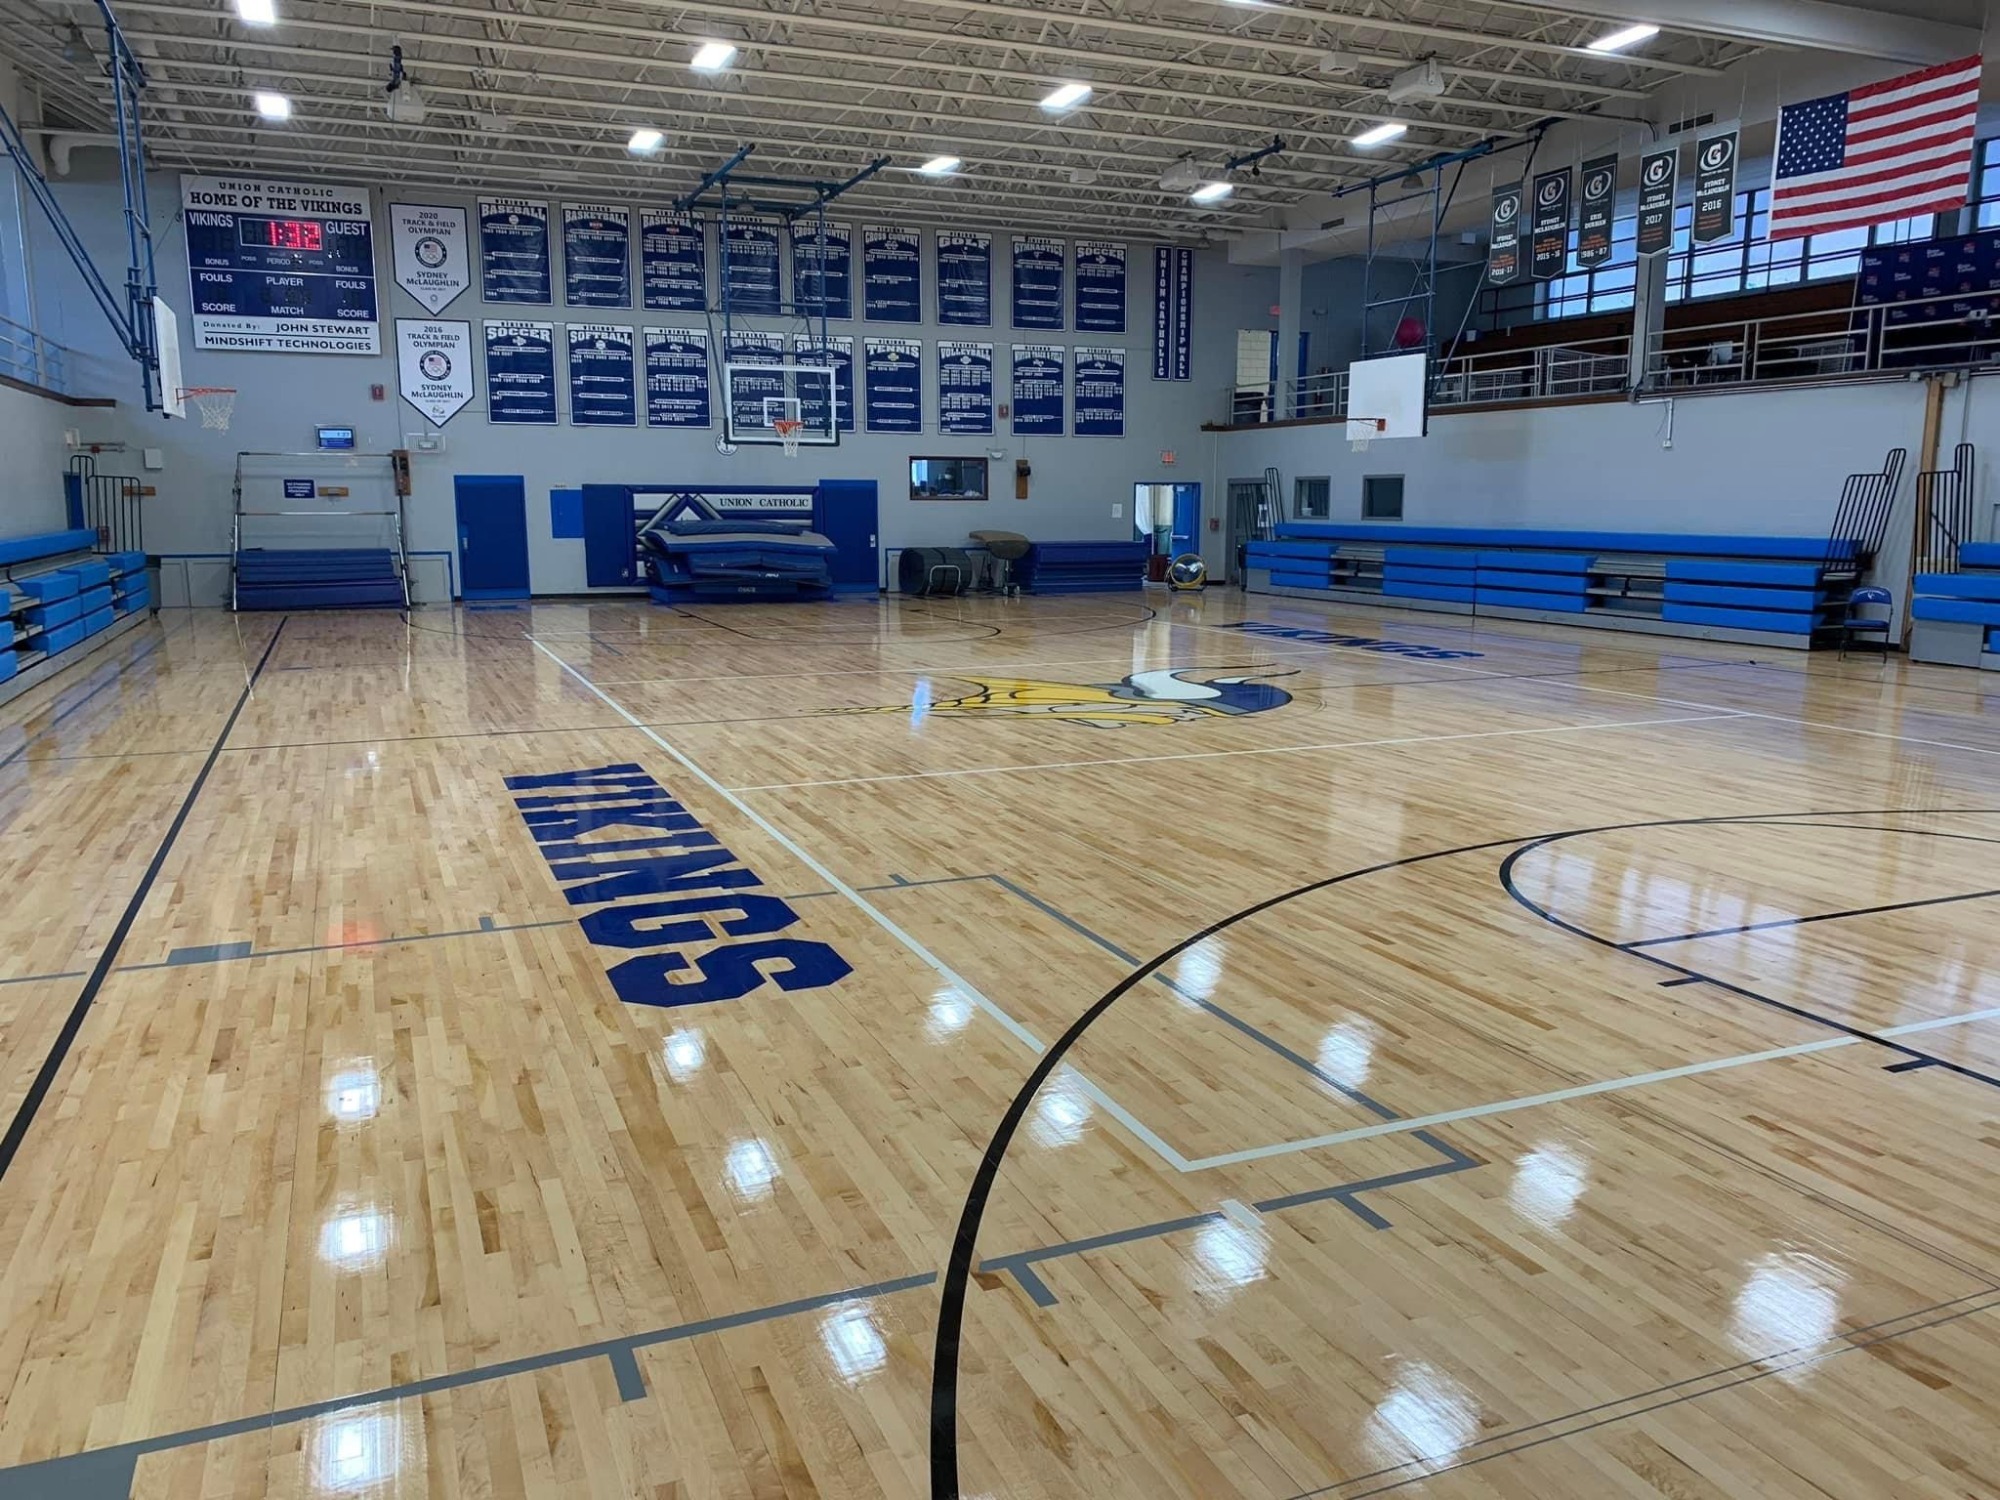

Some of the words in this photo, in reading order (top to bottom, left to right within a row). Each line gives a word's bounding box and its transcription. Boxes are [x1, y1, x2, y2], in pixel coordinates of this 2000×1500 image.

[219, 182, 261, 192] UNION
[268, 185, 333, 197] CATHOLIC
[190, 192, 237, 207] HOME
[241, 195, 262, 208] OF
[267, 197, 297, 211] THE
[300, 199, 363, 215] VIKINGS
[1702, 199, 1722, 211] 2016
[481, 204, 546, 221] BASEBALL
[565, 210, 627, 227] BASKETBALL
[189, 212, 234, 227] VIKINGS
[1645, 214, 1663, 225] 2017
[269, 221, 321, 249] 1:32
[325, 221, 367, 236] GUEST
[408, 226, 451, 235] OLYMPIAN
[865, 231, 887, 243] CROSS
[888, 233, 918, 247] COUNTRY
[939, 237, 990, 250] GOLF
[1014, 242, 1063, 257] GYMNASTICS
[1077, 247, 1125, 262] SOCCER
[205, 258, 229, 266] BONUS
[266, 257, 291, 266] PERIOD
[335, 265, 359, 274] BONUS
[416, 271, 448, 279] SYDNEY
[200, 273, 233, 283] FOULS
[266, 276, 304, 287] PLAYER
[406, 278, 459, 287] McLAUGHLIN
[335, 280, 367, 290] FOULS
[202, 302, 236, 313] SCORE
[271, 306, 304, 315] MATCH
[337, 309, 369, 318] SCORE
[203, 321, 242, 329] Donated
[276, 323, 309, 333] JOHN
[312, 324, 370, 335] STEWART
[487, 327, 551, 343] SOCCER
[570, 330, 631, 346] SOFTBALL
[204, 336, 273, 347] MINDSHIFT
[277, 338, 372, 351] TECHNOLOGIES
[413, 341, 456, 349] OLYMPIAN
[866, 344, 920, 358] TENNIS
[941, 348, 991, 361] VOLLEYBALL
[1178, 347, 1186, 378] WALL
[411, 391, 463, 399] McLAUGHLIN
[720, 498, 752, 507] UNION
[759, 498, 809, 507] CATHOLIC
[502, 763, 854, 1008] VIKINGS
